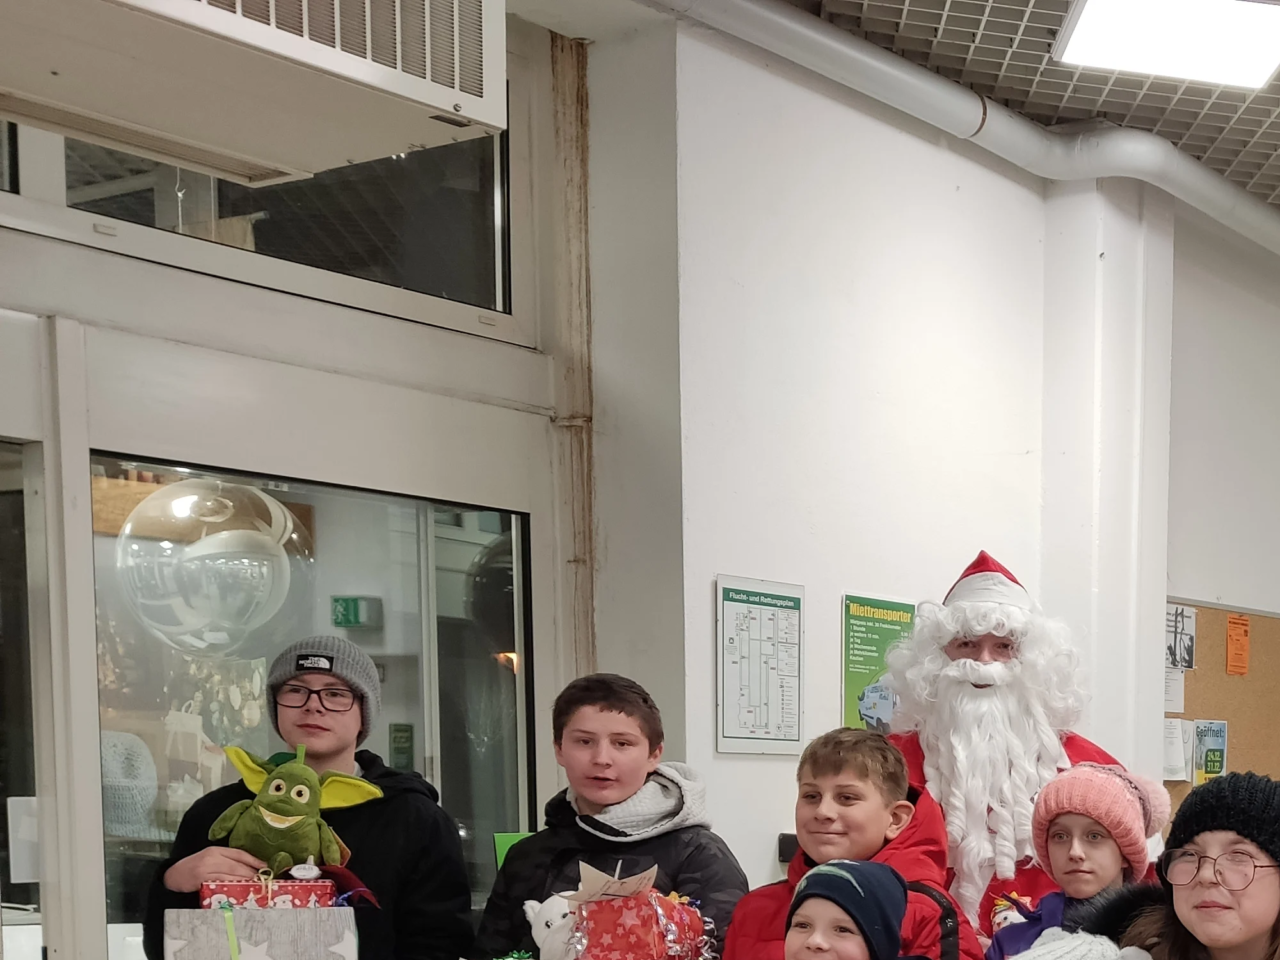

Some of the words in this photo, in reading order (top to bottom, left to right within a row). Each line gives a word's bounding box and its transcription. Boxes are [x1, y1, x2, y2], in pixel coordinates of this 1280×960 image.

[849, 603, 912, 623] Miettransporter
[1196, 725, 1225, 738] Geöffnet:
[1207, 751, 1222, 761] 24.12.
[1206, 762, 1222, 772] 31.12.
